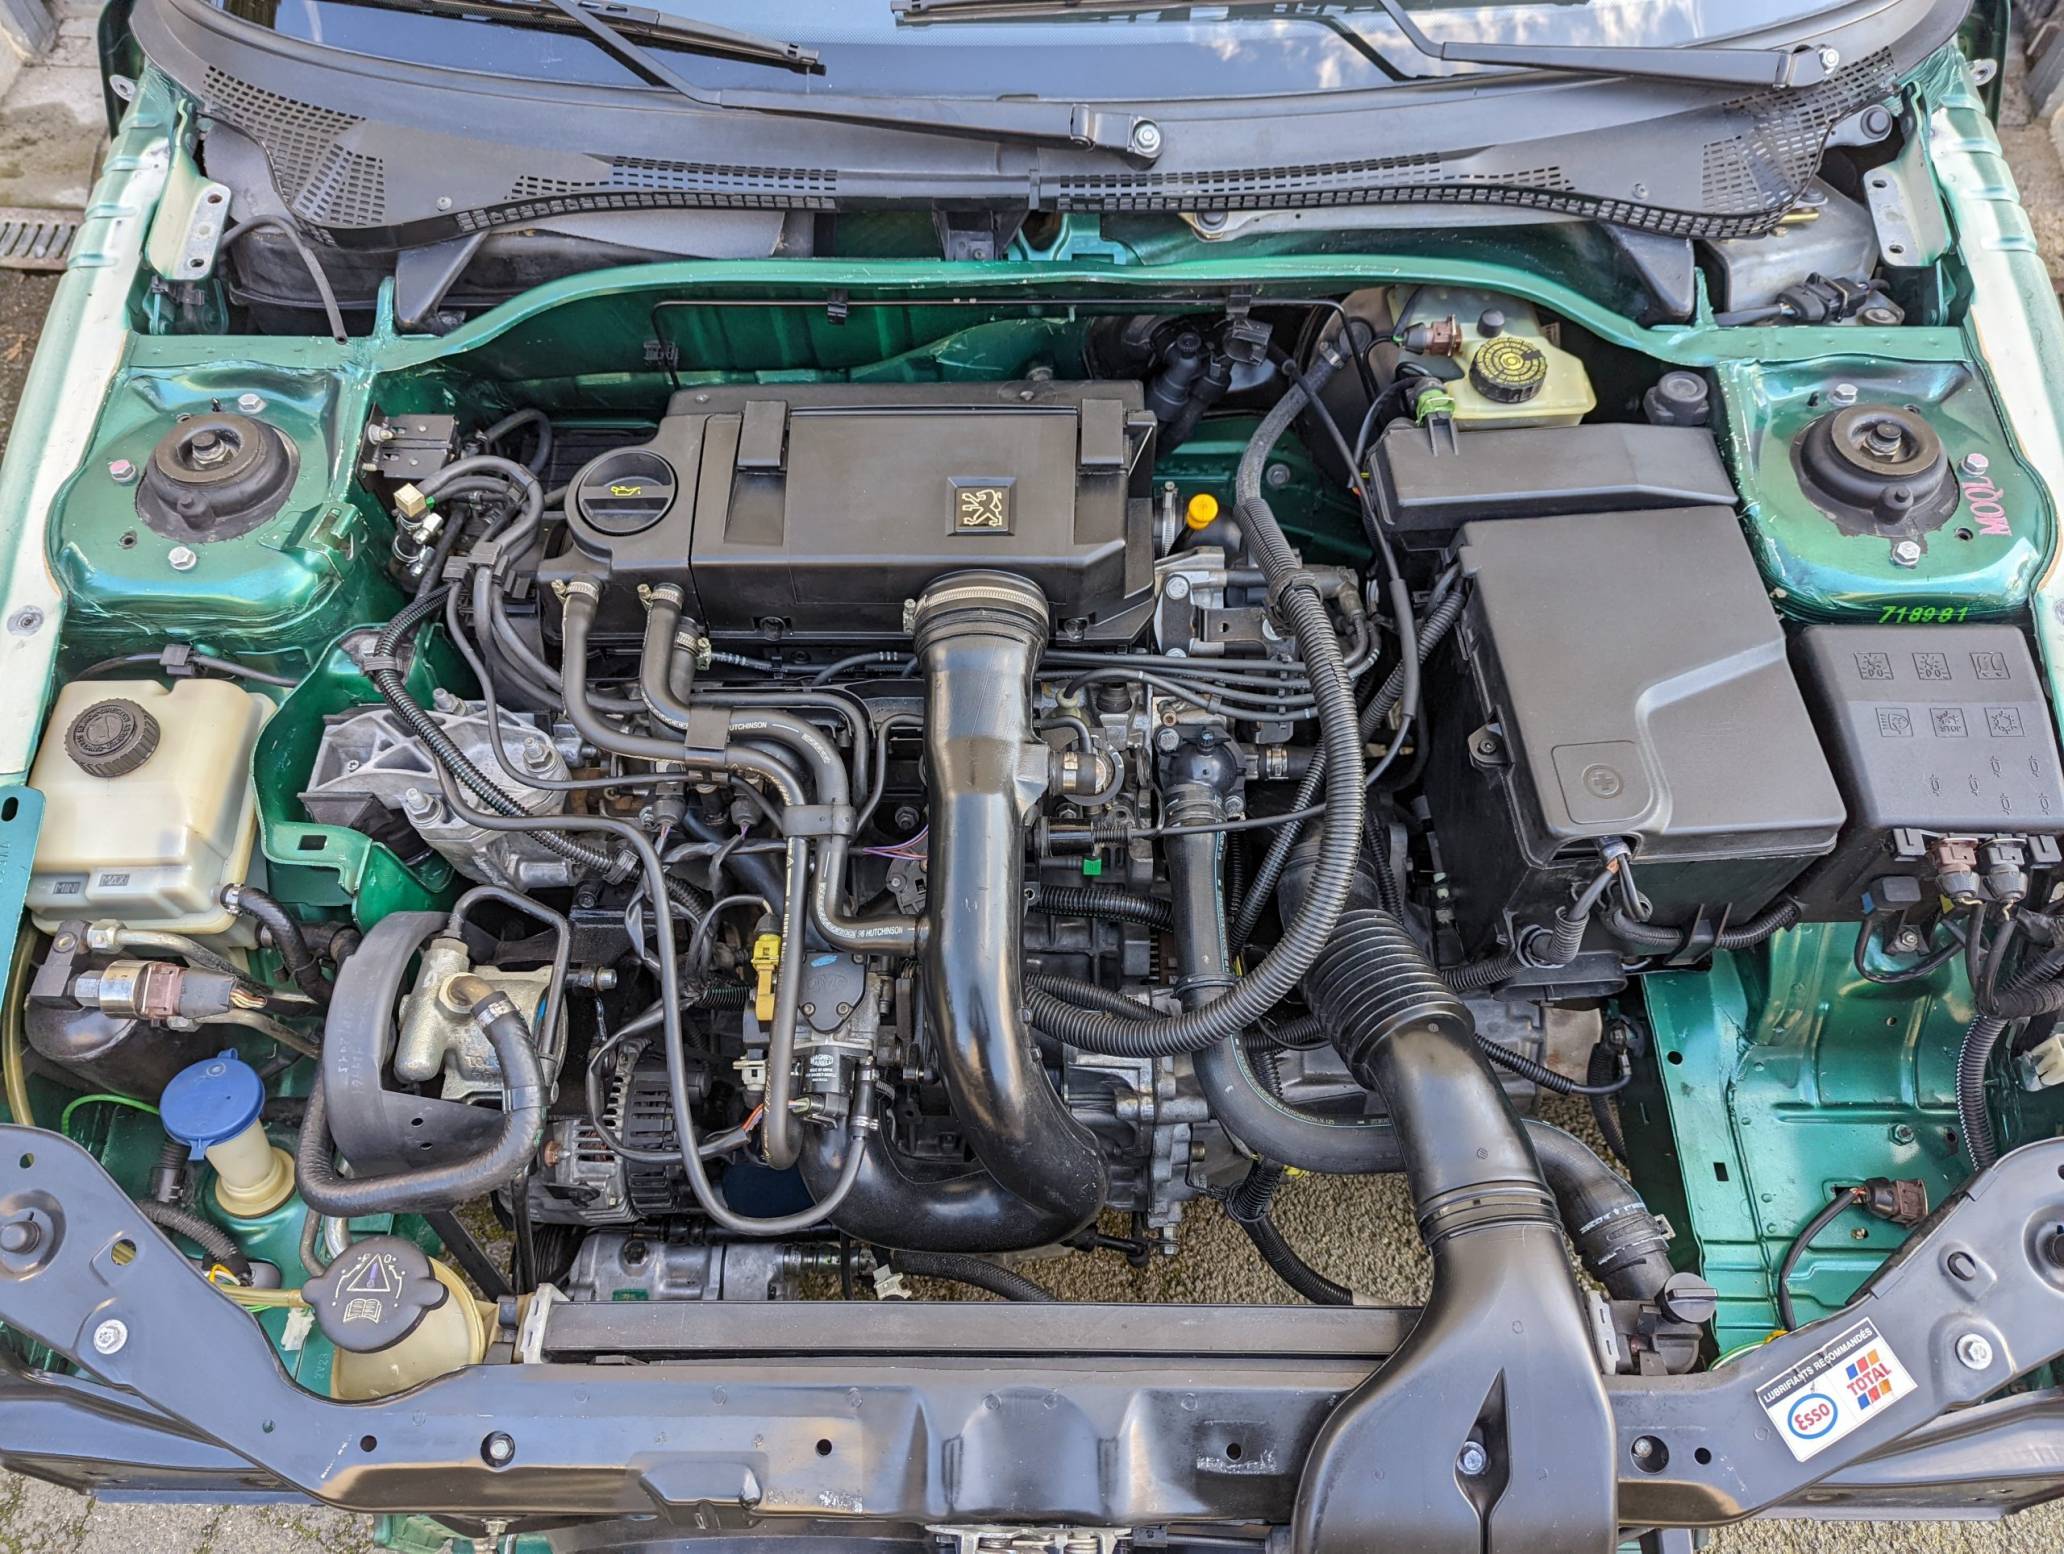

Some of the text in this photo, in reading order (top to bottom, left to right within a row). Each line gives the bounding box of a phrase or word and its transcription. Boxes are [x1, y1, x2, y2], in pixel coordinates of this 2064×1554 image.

[729, 721, 768, 732] UTCHINSON
[1763, 1327, 1873, 1404] LUBRIFIANTS RECOMMANDÉS
[1846, 1363, 1892, 1397] TOTAL
